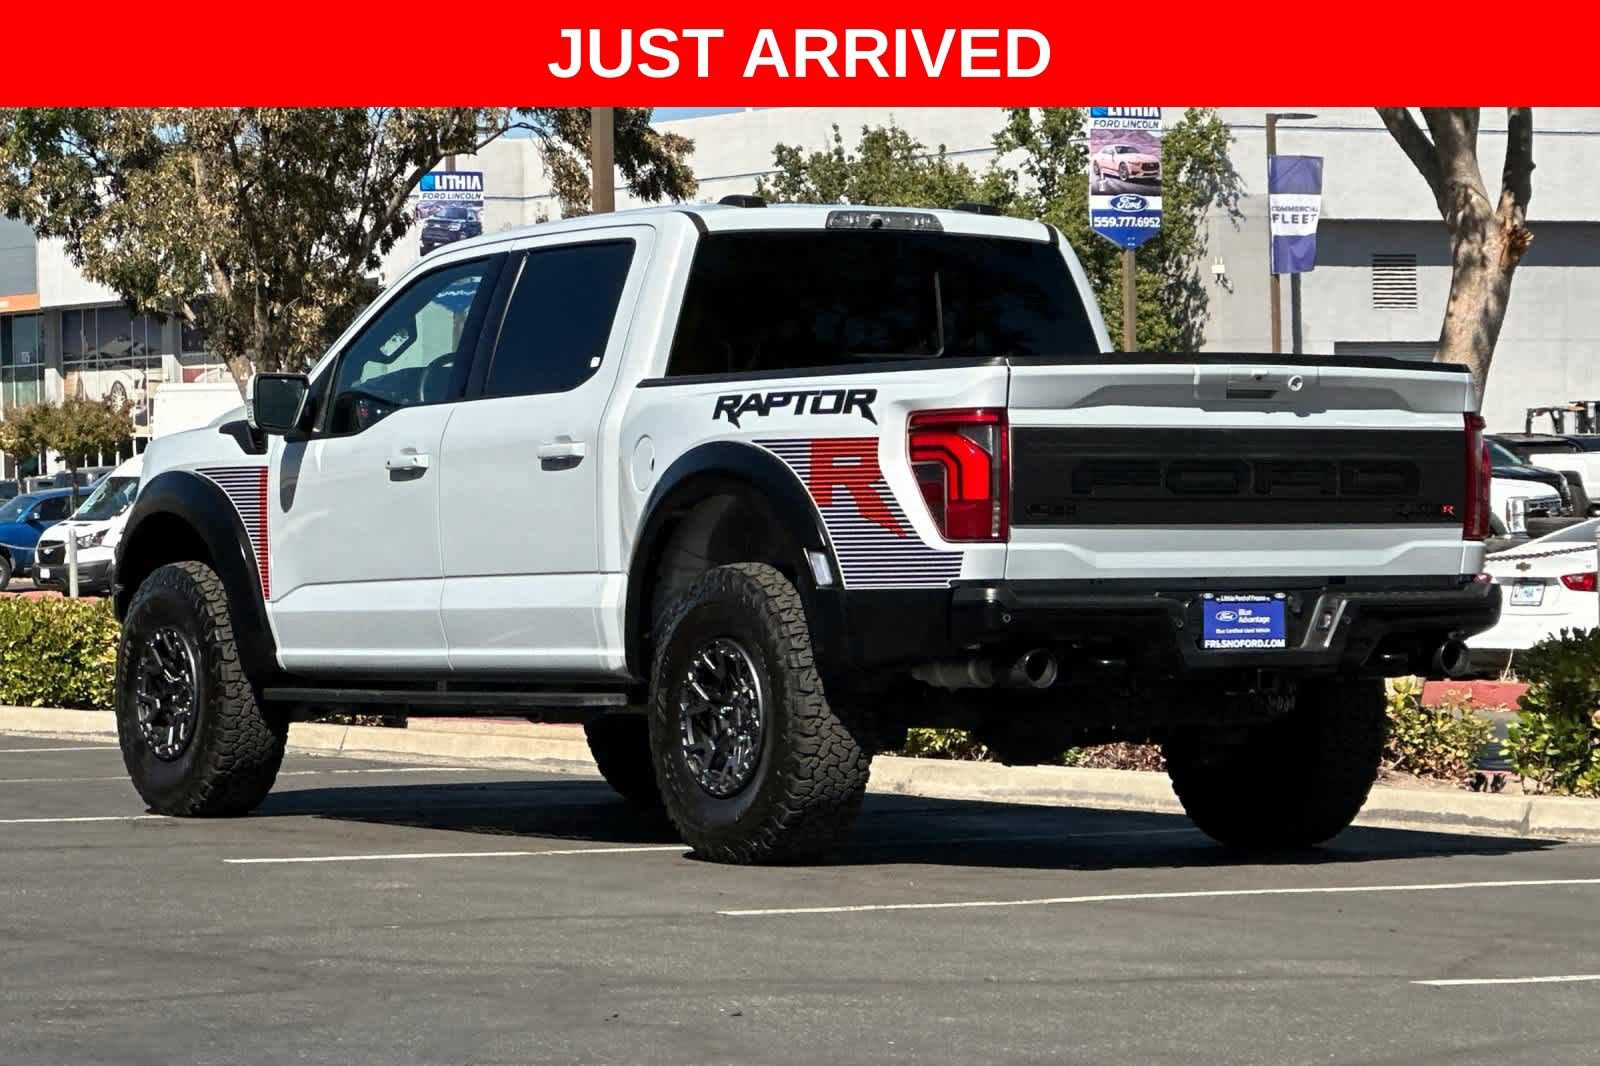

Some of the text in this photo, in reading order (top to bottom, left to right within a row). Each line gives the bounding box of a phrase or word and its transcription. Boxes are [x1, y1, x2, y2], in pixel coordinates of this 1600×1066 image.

[1093, 119, 1159, 129] FORD LINCOLN
[434, 175, 482, 190] LITHIA
[422, 192, 481, 200] FORD LINCOLN
[1115, 195, 1144, 211] Ford
[1093, 216, 1161, 229] 559.777.6952
[1271, 213, 1318, 224] FLEET
[712, 388, 878, 429] RAPTOR
[1071, 456, 1420, 496] FORD
[1238, 616, 1271, 624] Advantage
[1204, 639, 1286, 648] FRESNOFORD.COM
